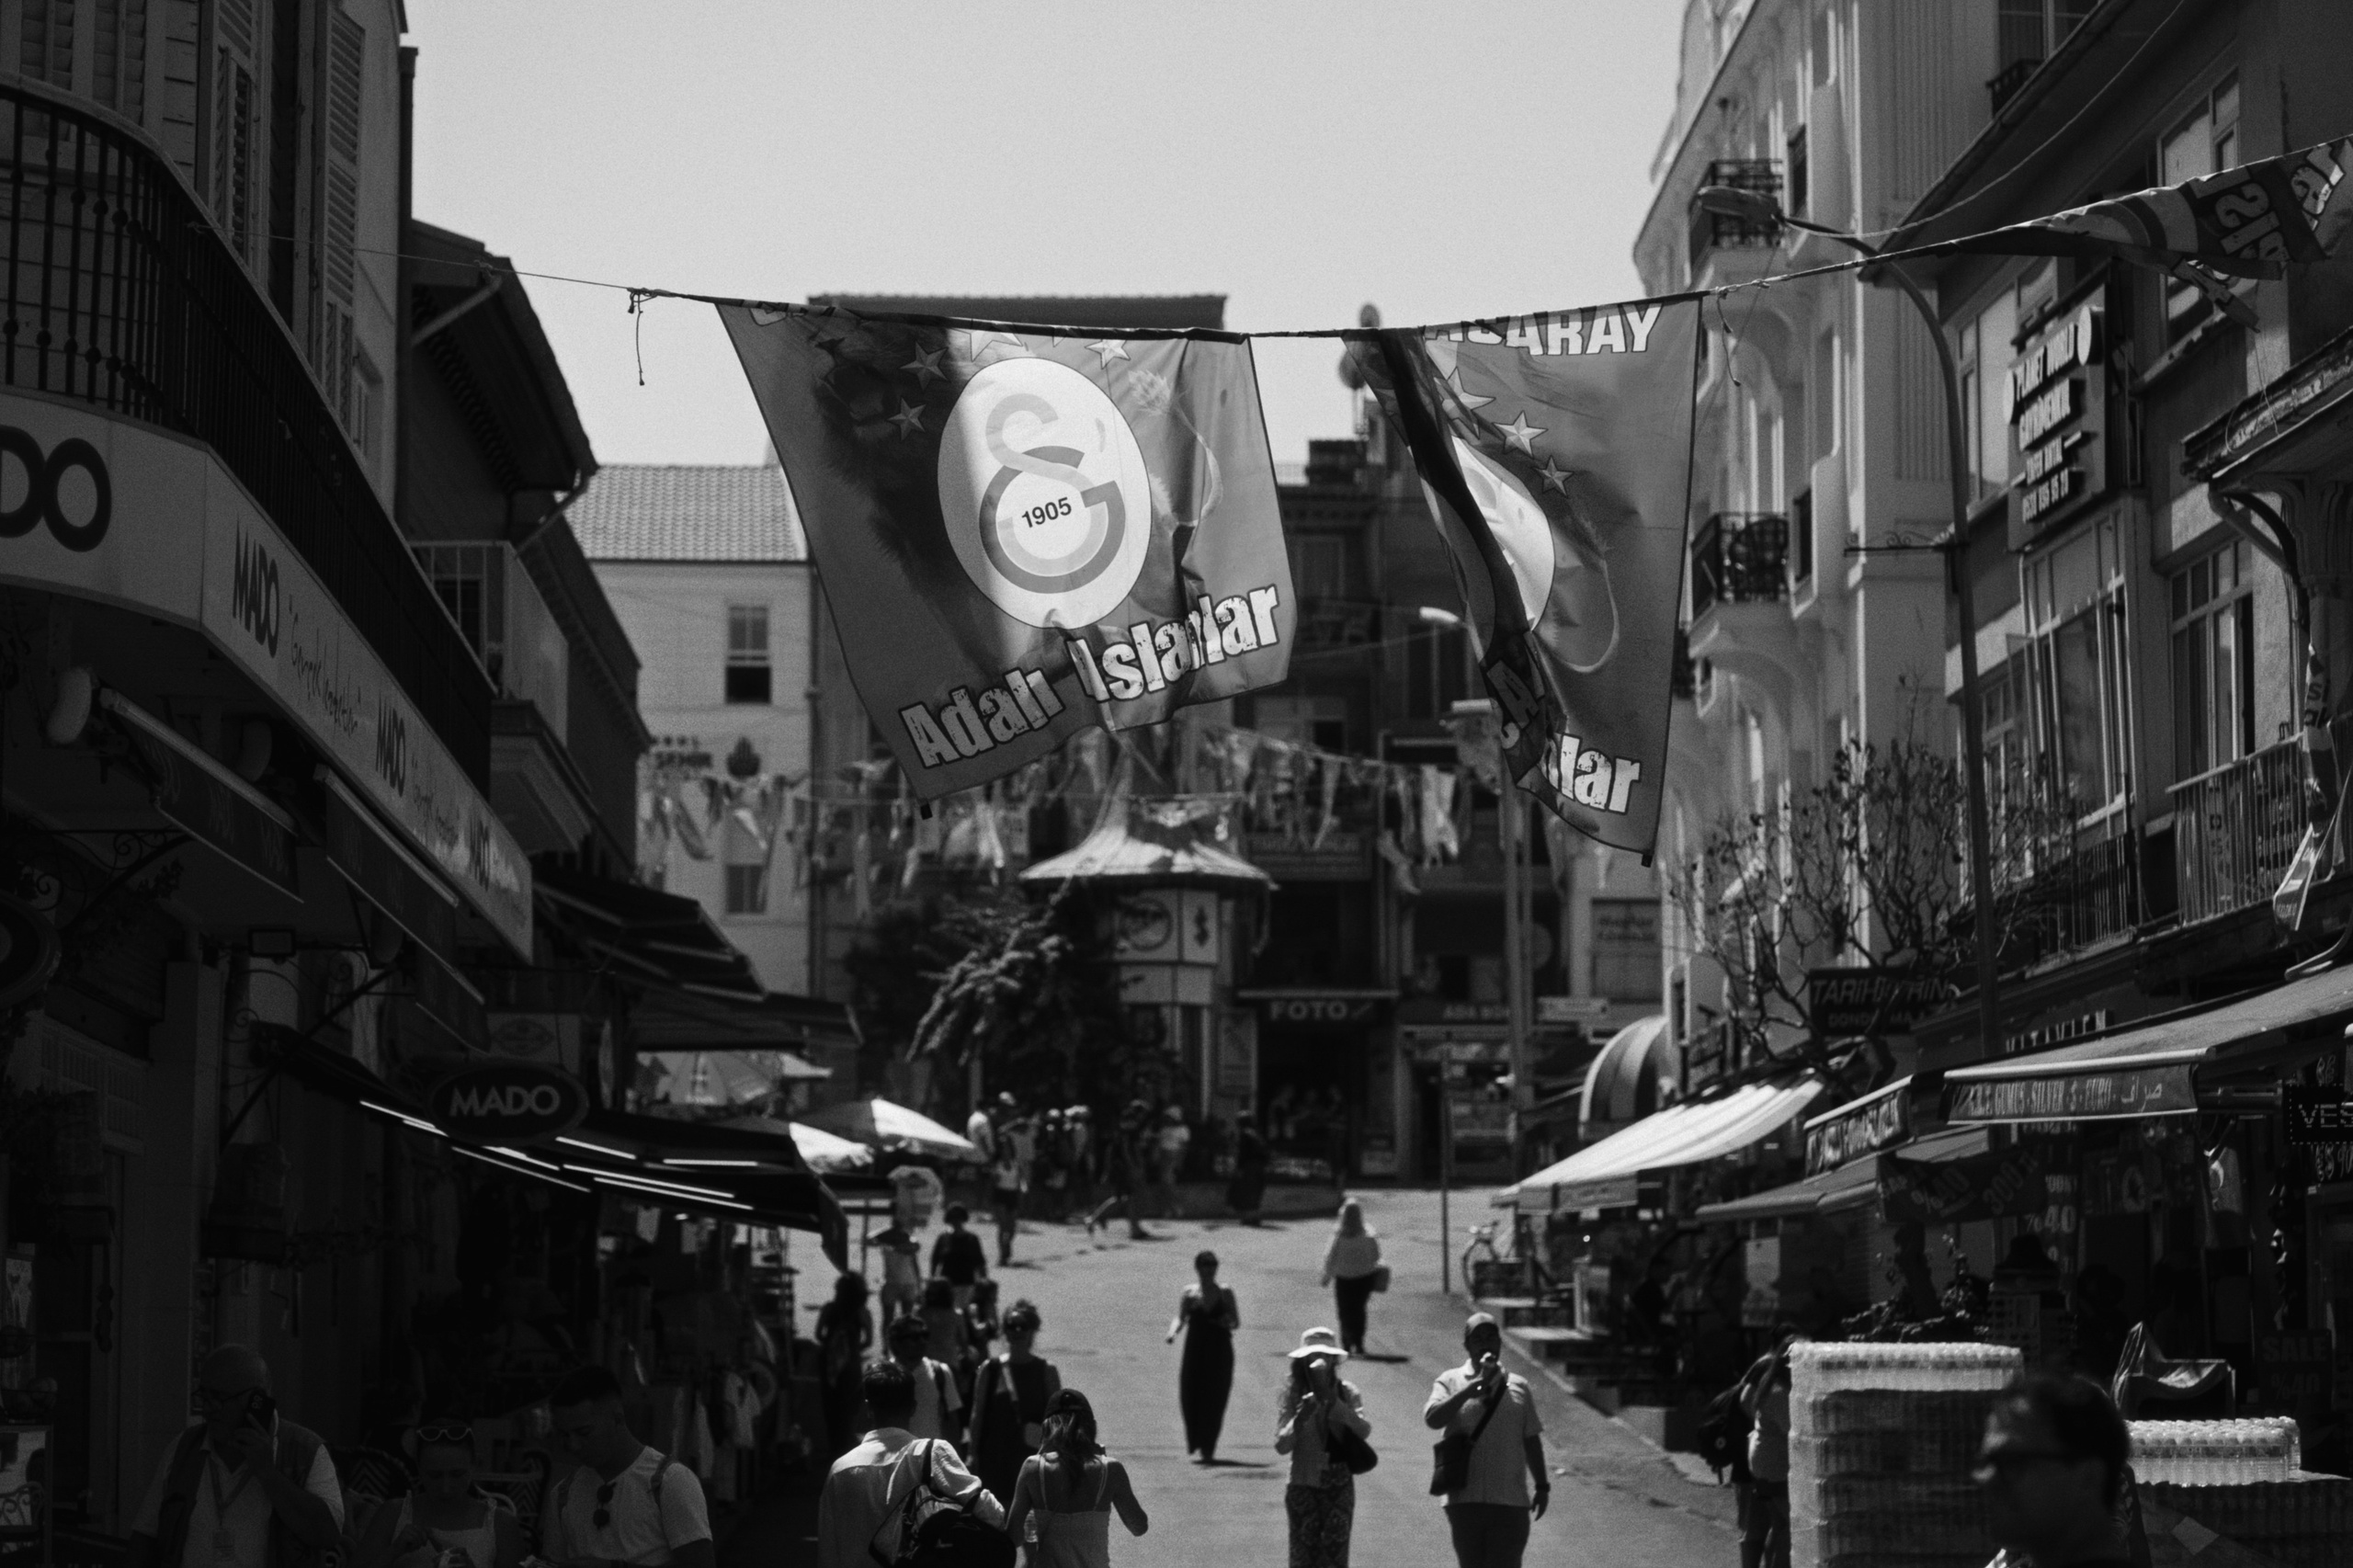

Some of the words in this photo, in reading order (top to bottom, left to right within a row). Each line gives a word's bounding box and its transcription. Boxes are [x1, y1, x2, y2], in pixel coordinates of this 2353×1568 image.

[1021, 495, 1073, 529] 1905
[233, 516, 279, 659] MADO
[375, 691, 406, 798] MADO
[1269, 999, 1348, 1021] FOTO
[448, 1083, 561, 1118] MADO
[2031, 1080, 2065, 1114] SILVER
[2024, 1204, 2077, 1234] %40
[2262, 1335, 2328, 1363] SALE
